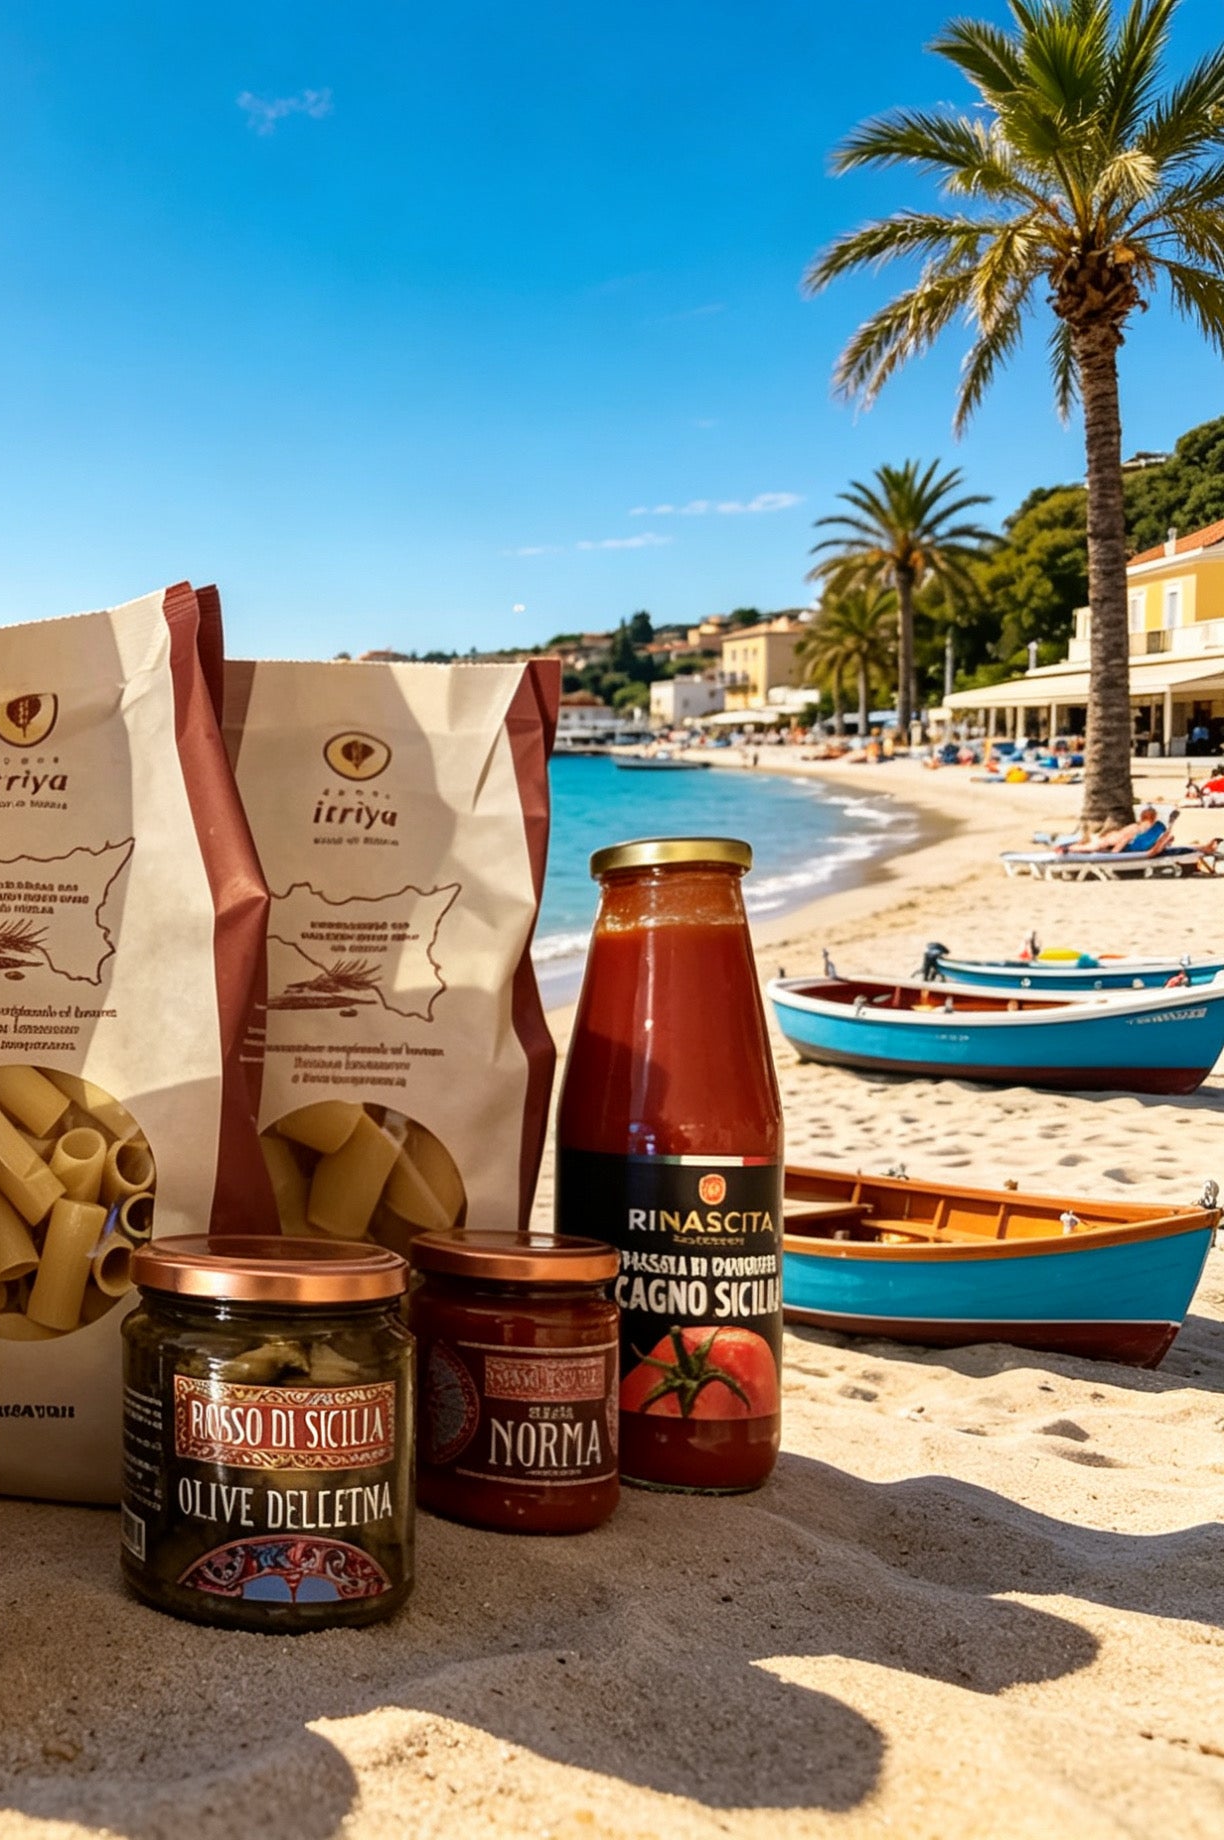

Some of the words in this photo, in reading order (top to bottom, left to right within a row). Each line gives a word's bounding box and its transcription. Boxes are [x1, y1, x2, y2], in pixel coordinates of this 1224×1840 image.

[628, 1208, 774, 1233] RINASCITA
[615, 1275, 708, 1317] CAGNO
[191, 1400, 263, 1446] ROSSO
[271, 1409, 295, 1449] DI
[304, 1406, 385, 1449] SICILIA
[488, 1418, 602, 1468] NORMA
[178, 1477, 255, 1527] OLIVE
